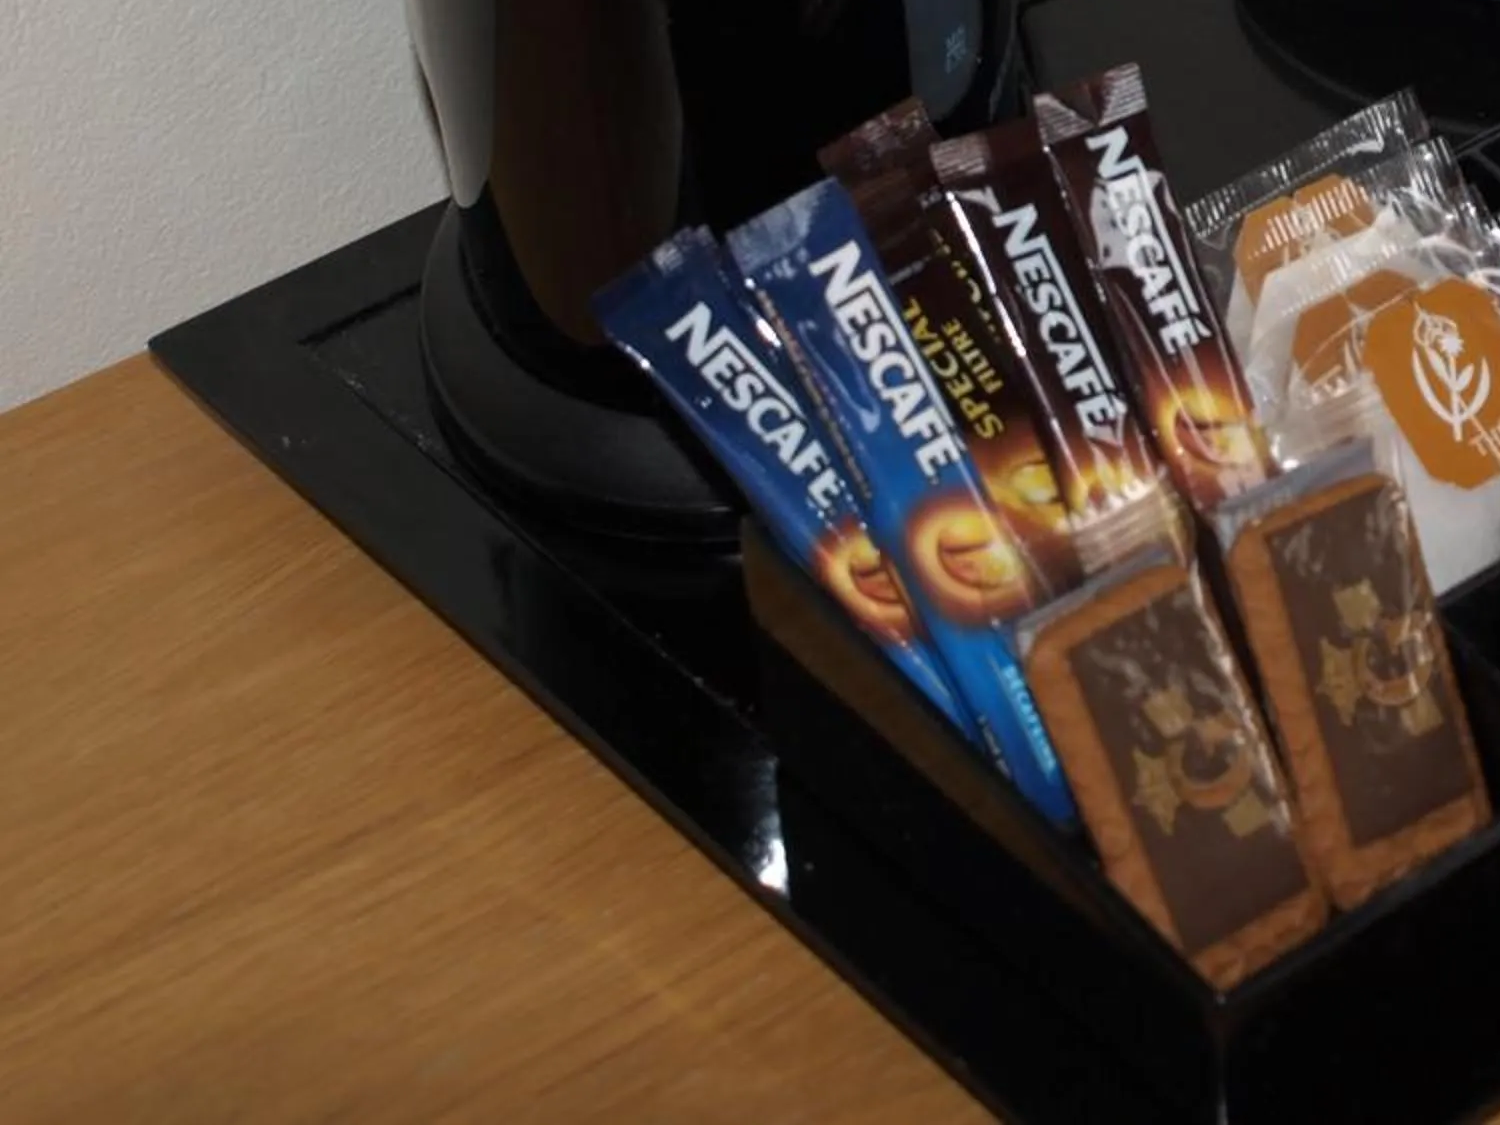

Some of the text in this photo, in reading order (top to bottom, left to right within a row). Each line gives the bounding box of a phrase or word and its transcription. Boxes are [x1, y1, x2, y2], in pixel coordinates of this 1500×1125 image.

[994, 203, 1124, 440] NESCAFÉ
[1087, 124, 1212, 354] NESCAFÉ
[809, 239, 968, 481] NESCAFÉ
[942, 317, 1004, 395] FILTRE
